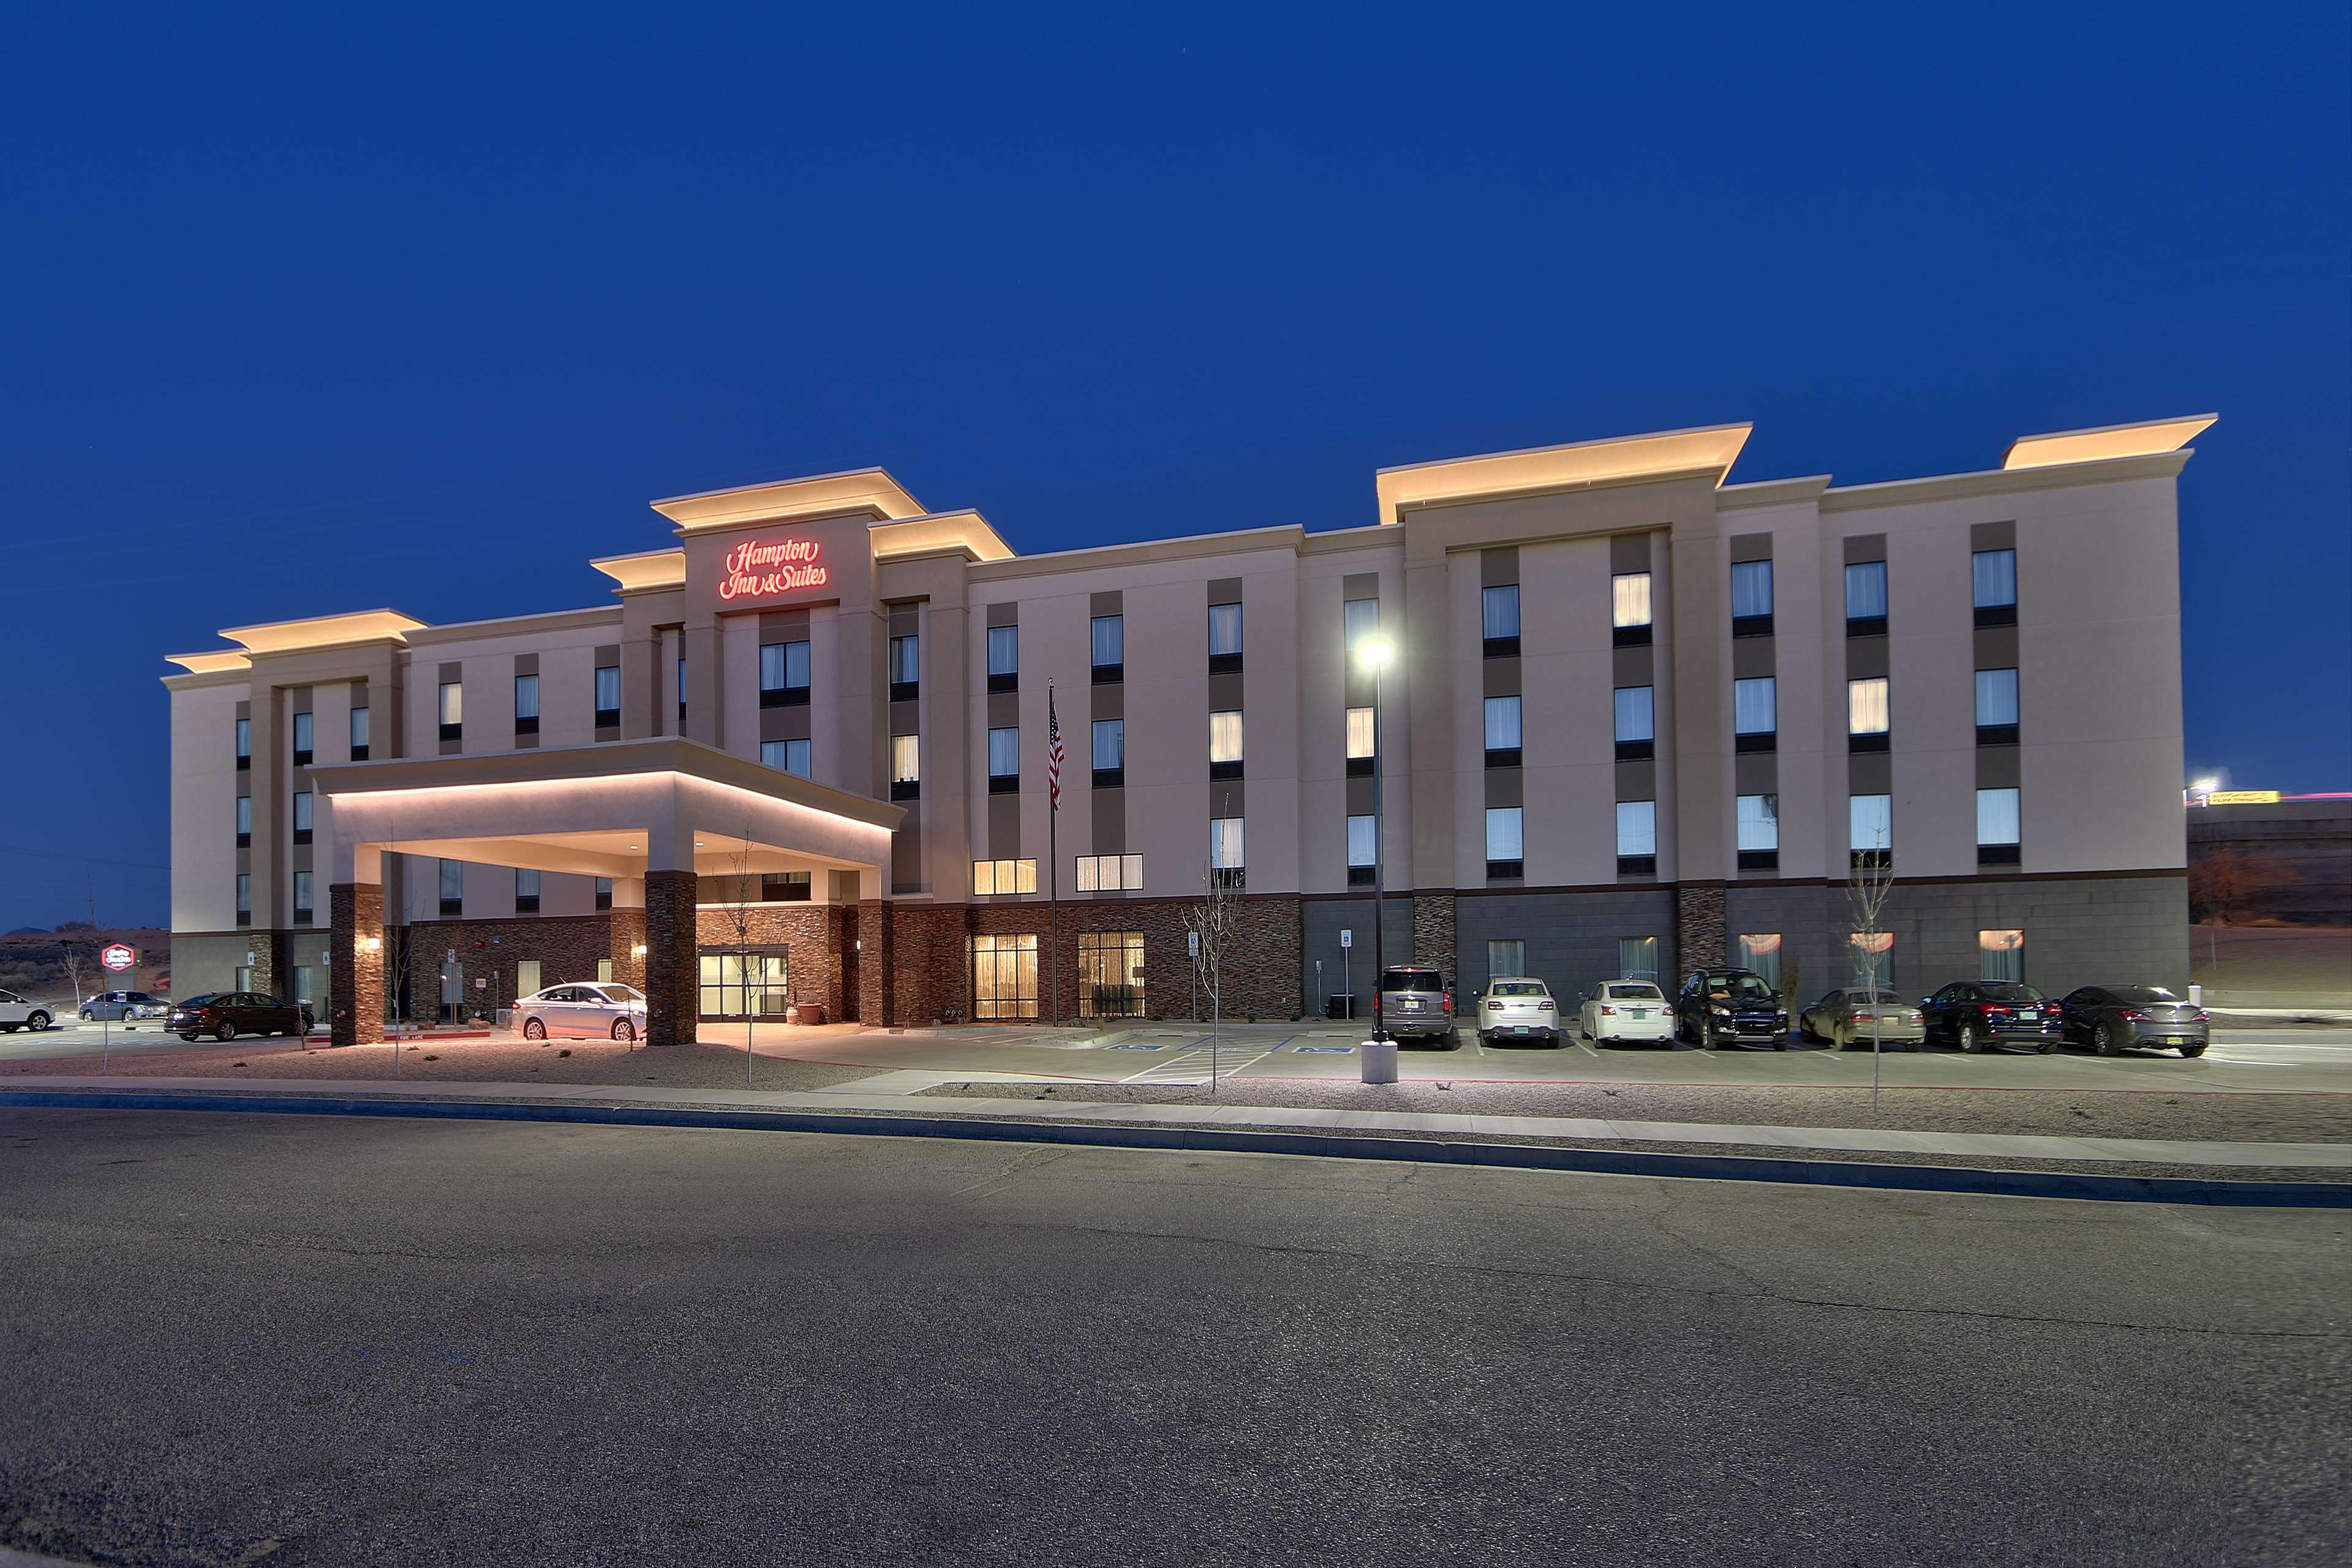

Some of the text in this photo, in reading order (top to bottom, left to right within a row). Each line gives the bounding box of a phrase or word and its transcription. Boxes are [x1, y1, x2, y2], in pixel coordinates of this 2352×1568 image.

[726, 539, 818, 573] Hampton
[720, 564, 827, 600] Inn & Suites
